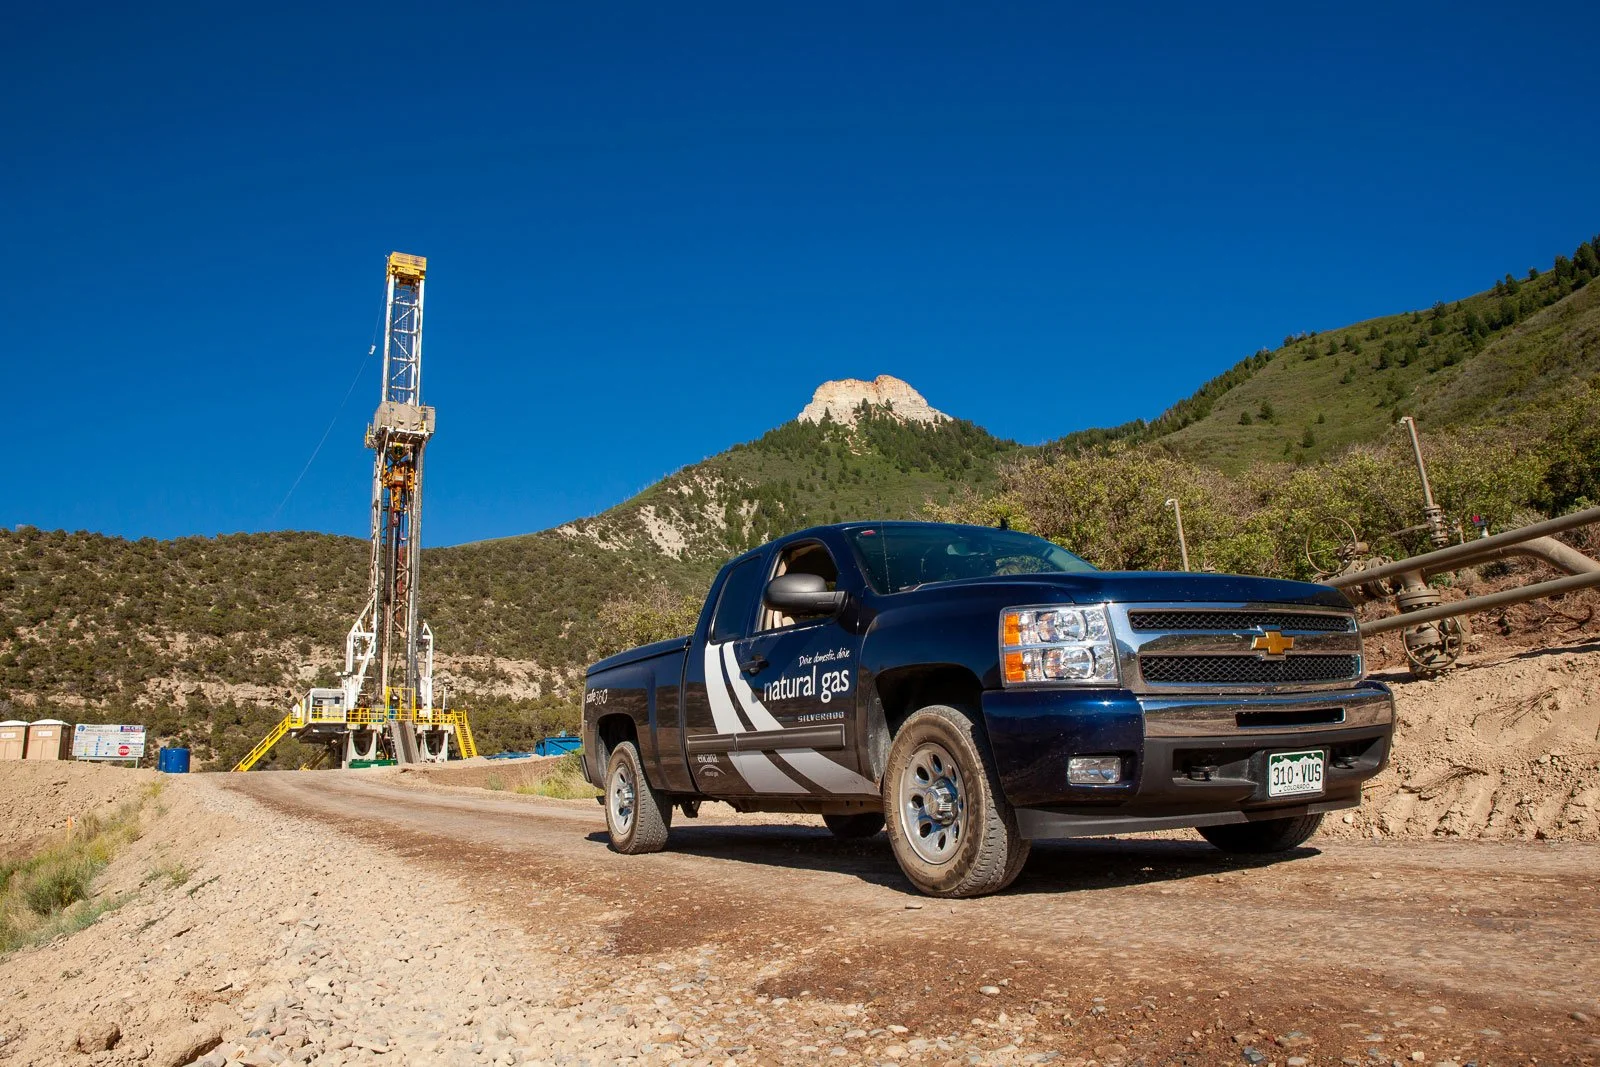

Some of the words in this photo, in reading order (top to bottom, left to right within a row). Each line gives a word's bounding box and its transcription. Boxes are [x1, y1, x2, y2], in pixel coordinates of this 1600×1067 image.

[799, 655, 813, 667] Drive
[836, 647, 850, 659] drive
[763, 665, 816, 702] natural
[821, 669, 850, 703] gas
[797, 711, 845, 723] SILVERADO
[1283, 783, 1310, 791] COLORADO
